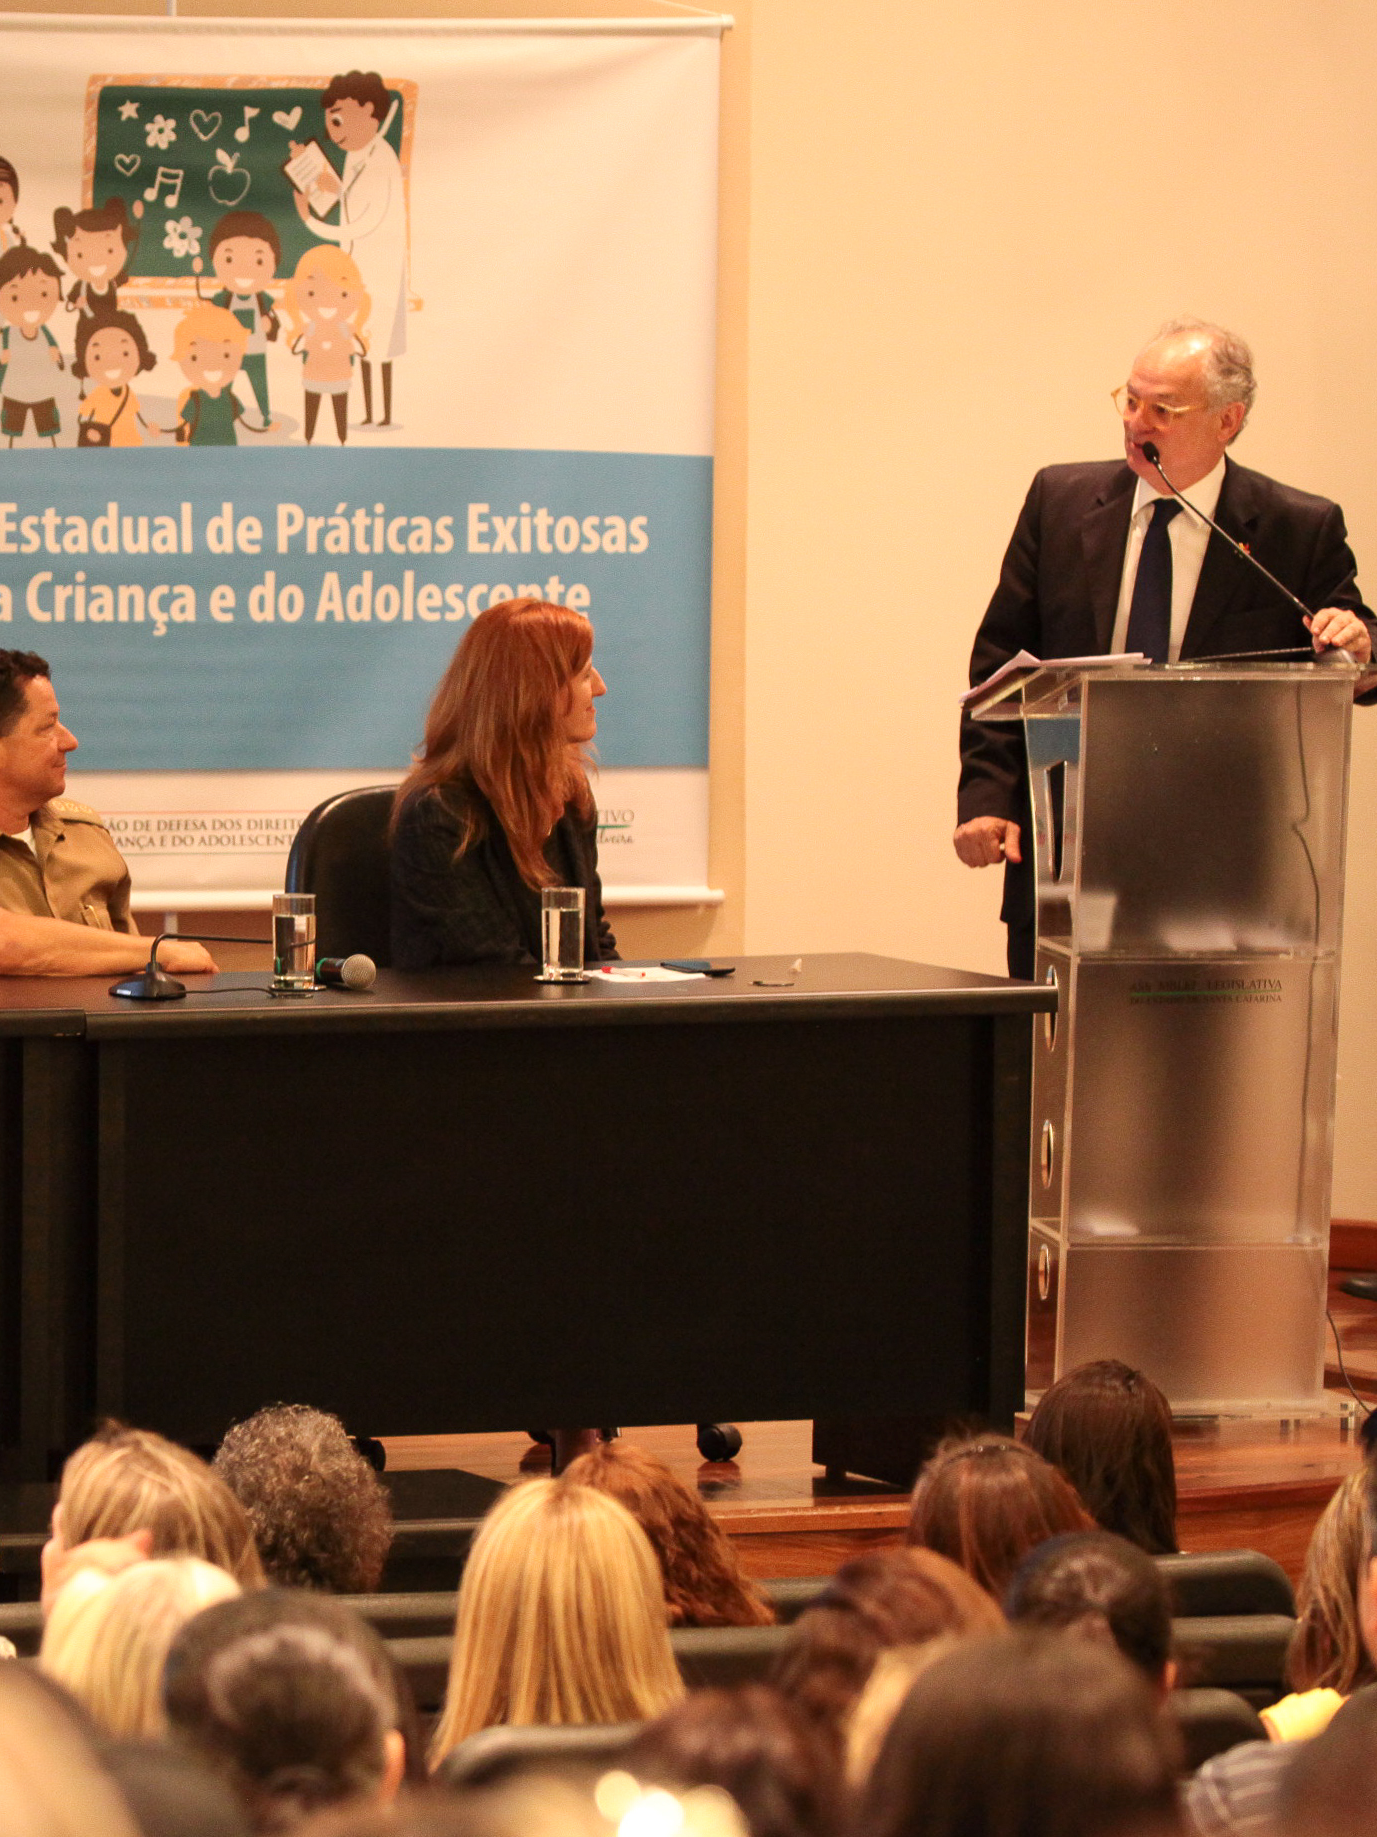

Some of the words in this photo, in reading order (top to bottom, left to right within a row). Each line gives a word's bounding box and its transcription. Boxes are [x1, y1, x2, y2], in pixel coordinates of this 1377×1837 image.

[206, 502, 263, 554] de
[277, 502, 454, 554] Práticas
[467, 502, 649, 554] Exitosas
[26, 570, 196, 635] Criança
[209, 583, 236, 622] e
[248, 570, 304, 622] do
[133, 819, 151, 831] DE
[156, 818, 207, 831] DEFESA
[211, 818, 242, 831] DOS
[247, 818, 302, 830] DIREIT
[115, 835, 155, 850] ANÇA
[160, 835, 167, 847] E
[172, 834, 195, 847] DO
[198, 834, 295, 847] ADOLESCENT
